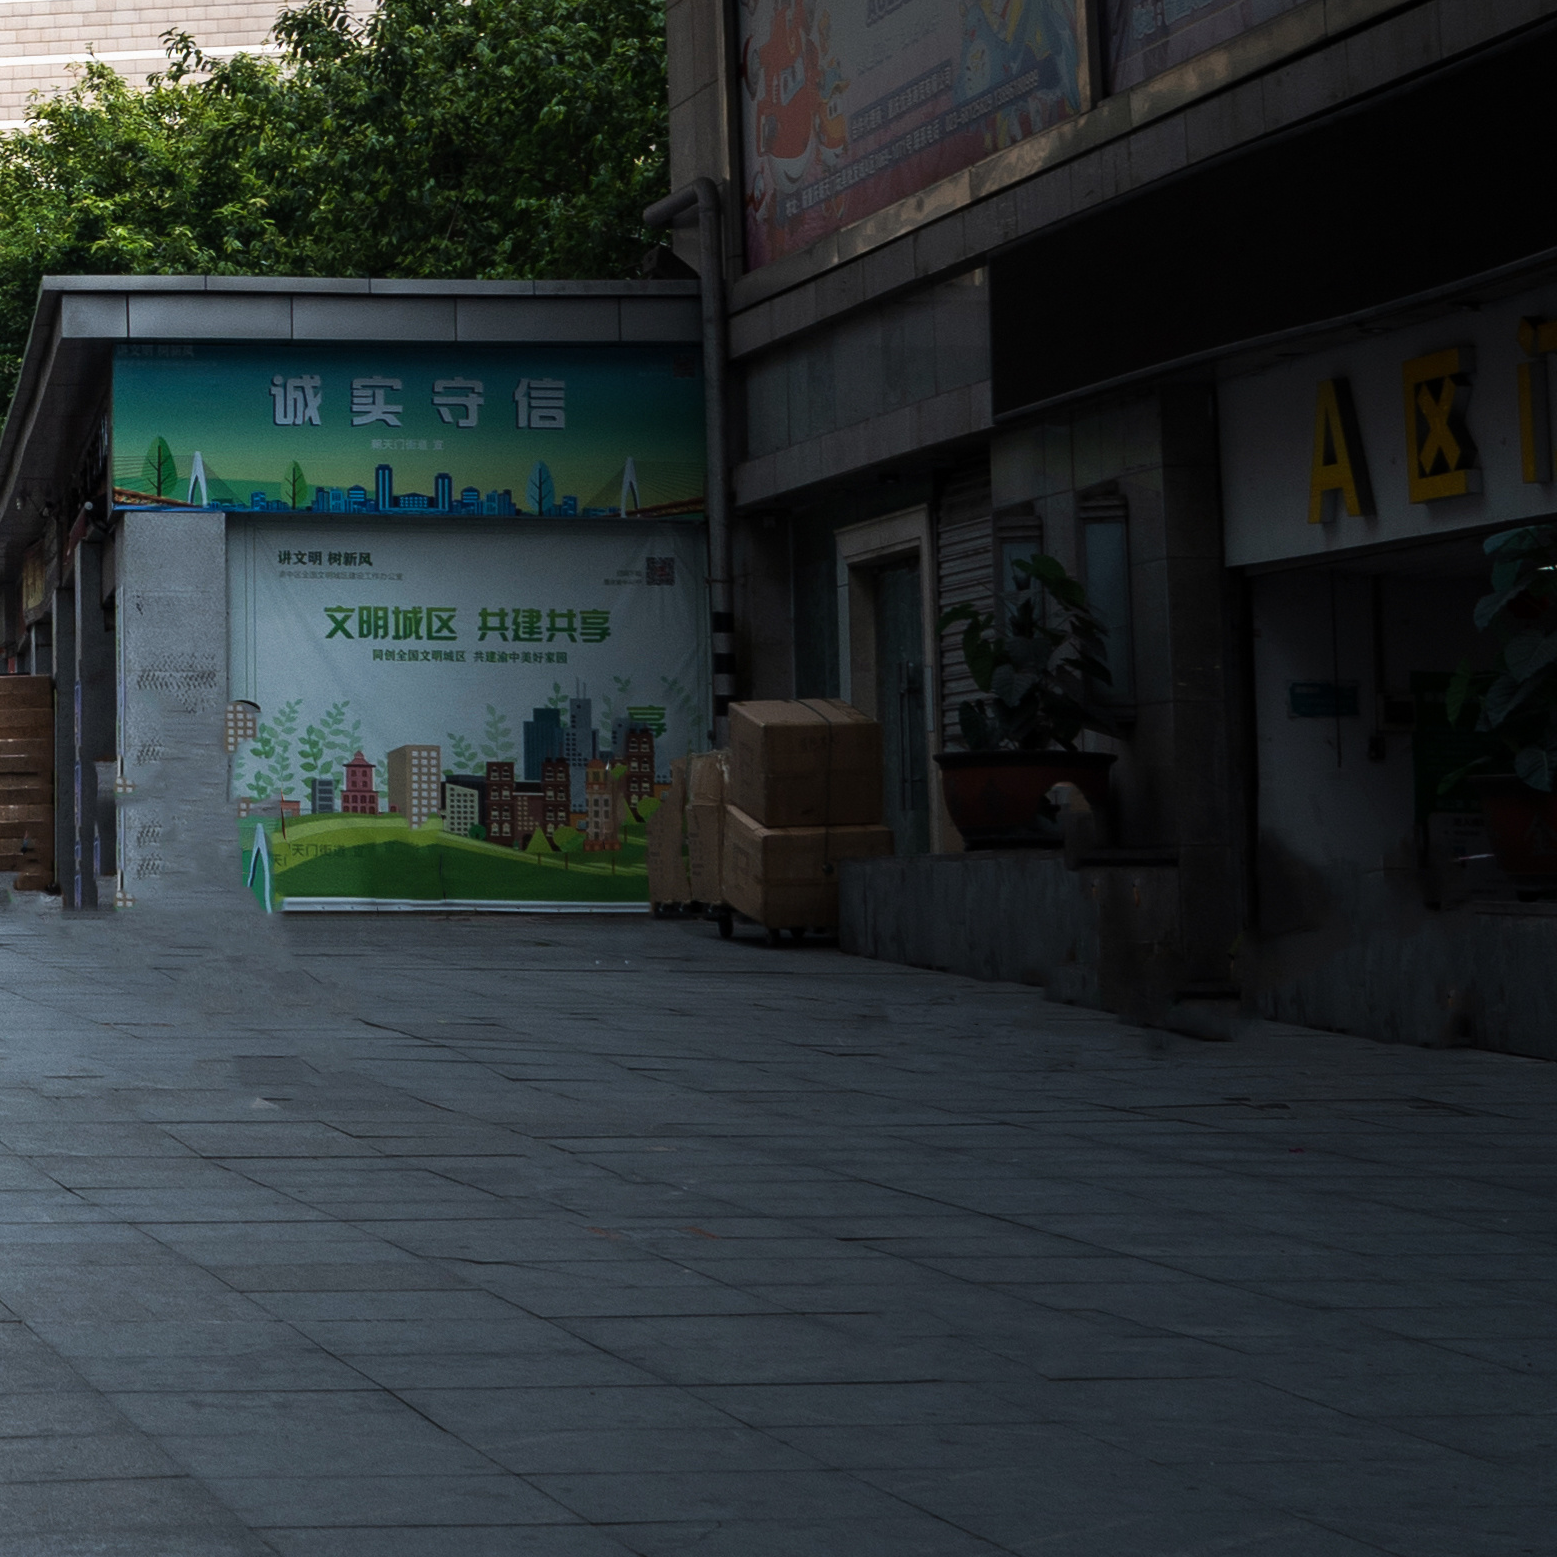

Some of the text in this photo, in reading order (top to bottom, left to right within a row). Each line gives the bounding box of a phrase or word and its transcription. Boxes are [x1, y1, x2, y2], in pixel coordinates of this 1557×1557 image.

[271, 375, 566, 429] 诚实守信
[278, 549, 373, 567] 讲文明 树新风
[325, 605, 613, 644] 文明城区 共建共享
[372, 648, 568, 665] 同创全国文明城区 共建渝中美好家园
